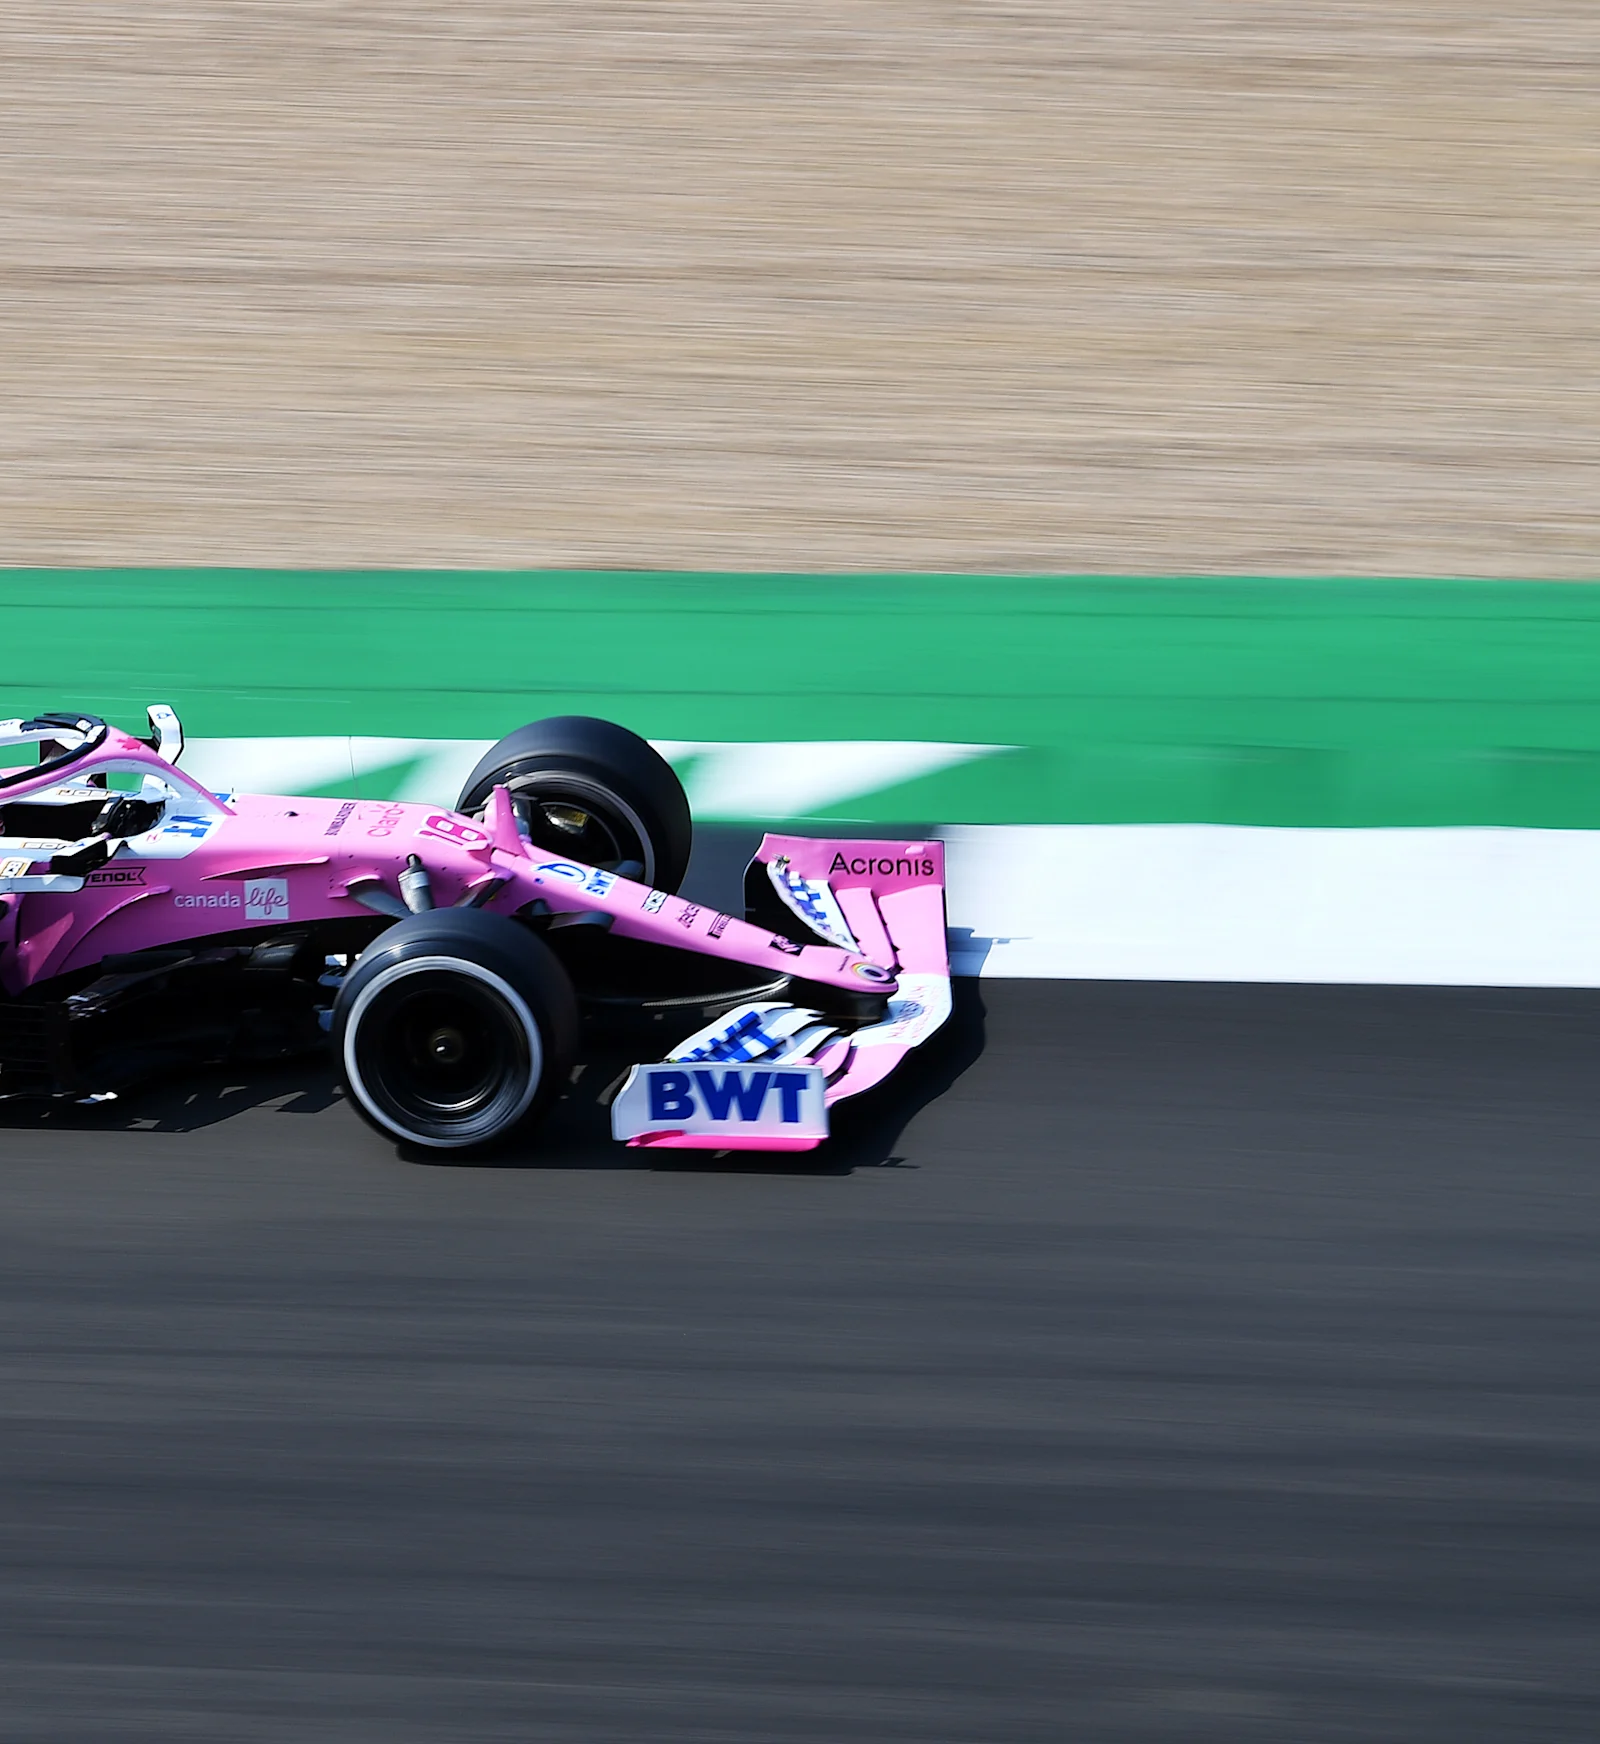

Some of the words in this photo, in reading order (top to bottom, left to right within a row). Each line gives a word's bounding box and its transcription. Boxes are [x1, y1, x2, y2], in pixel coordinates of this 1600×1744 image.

[87, 872, 138, 883] ENOL
[828, 852, 935, 877] Acronis
[174, 891, 240, 908] canada
[246, 887, 289, 915] life
[647, 1070, 811, 1124] BWT
